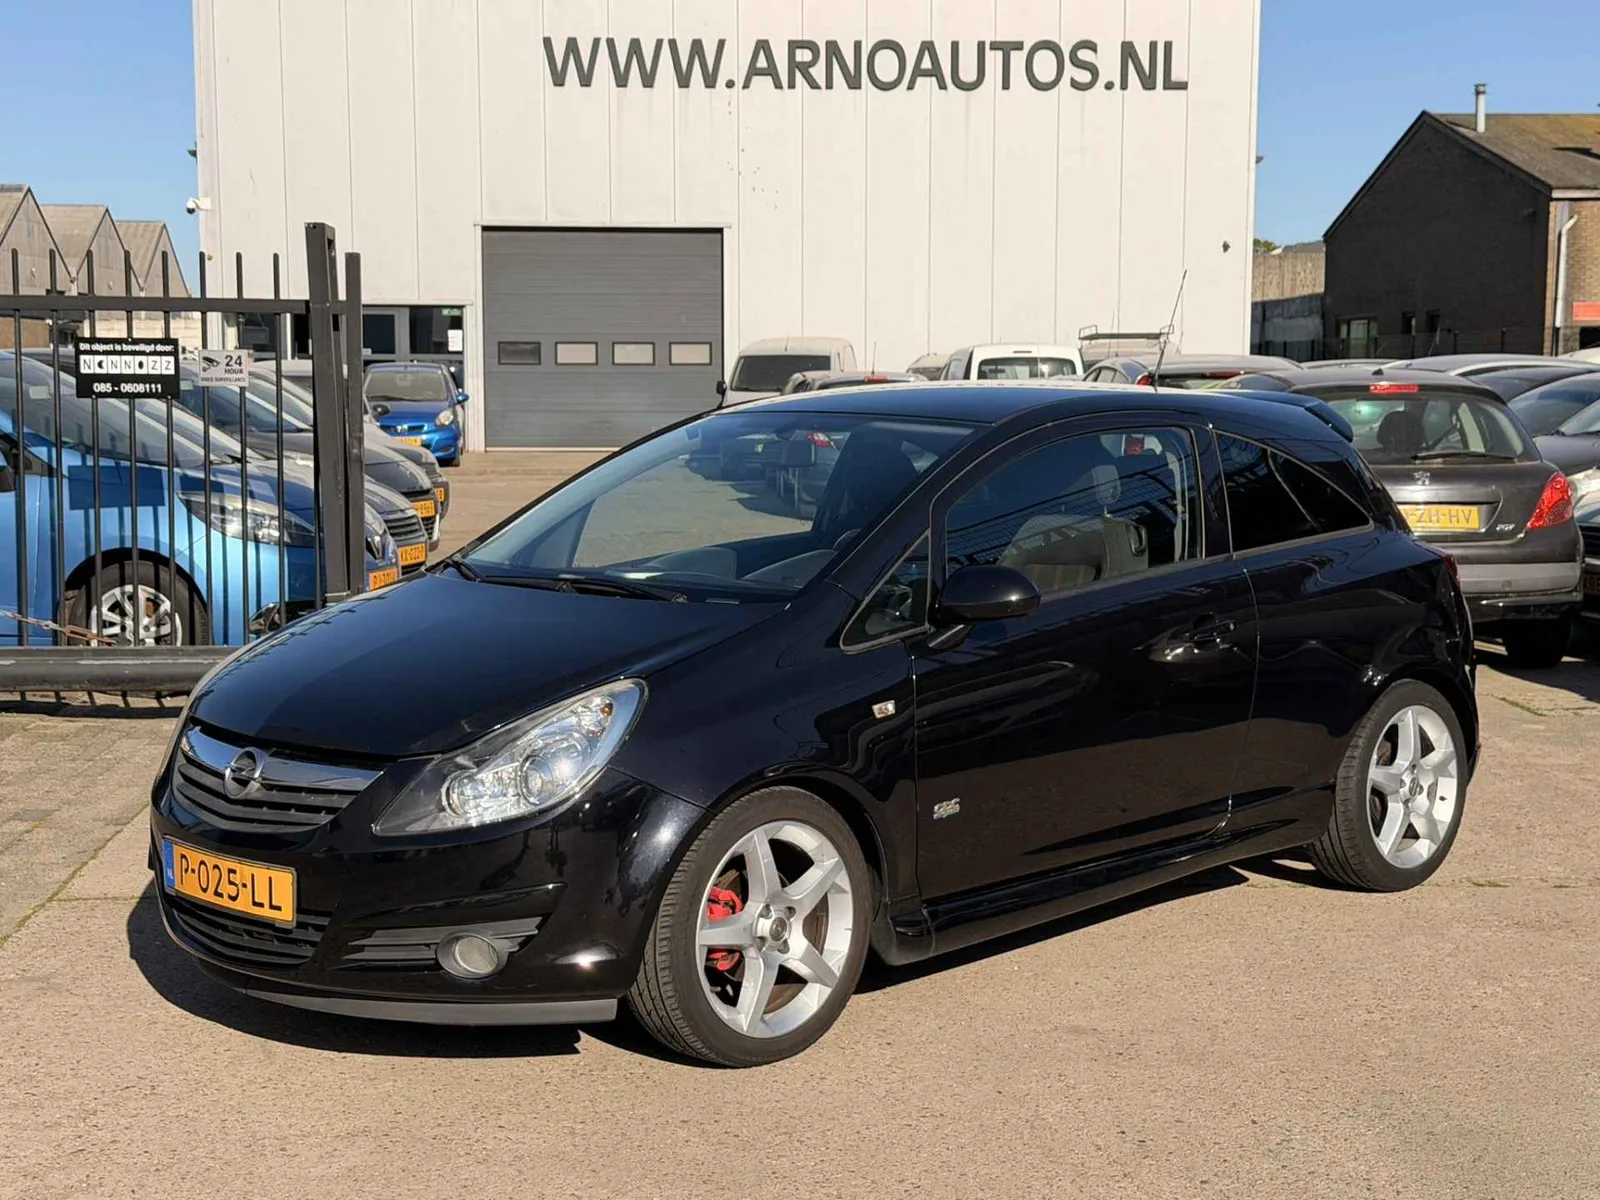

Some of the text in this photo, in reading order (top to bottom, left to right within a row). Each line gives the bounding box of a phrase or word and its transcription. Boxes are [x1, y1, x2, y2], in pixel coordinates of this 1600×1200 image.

[543, 36, 1189, 91] WWW.ARNOAUTOS.NL
[79, 342, 91, 351] Dit
[91, 342, 114, 353] object
[114, 343, 122, 352] is
[225, 354, 243, 367] 24
[93, 382, 113, 393] 085
[120, 383, 162, 393] 0608111
[179, 852, 282, 912] P-025-LL
